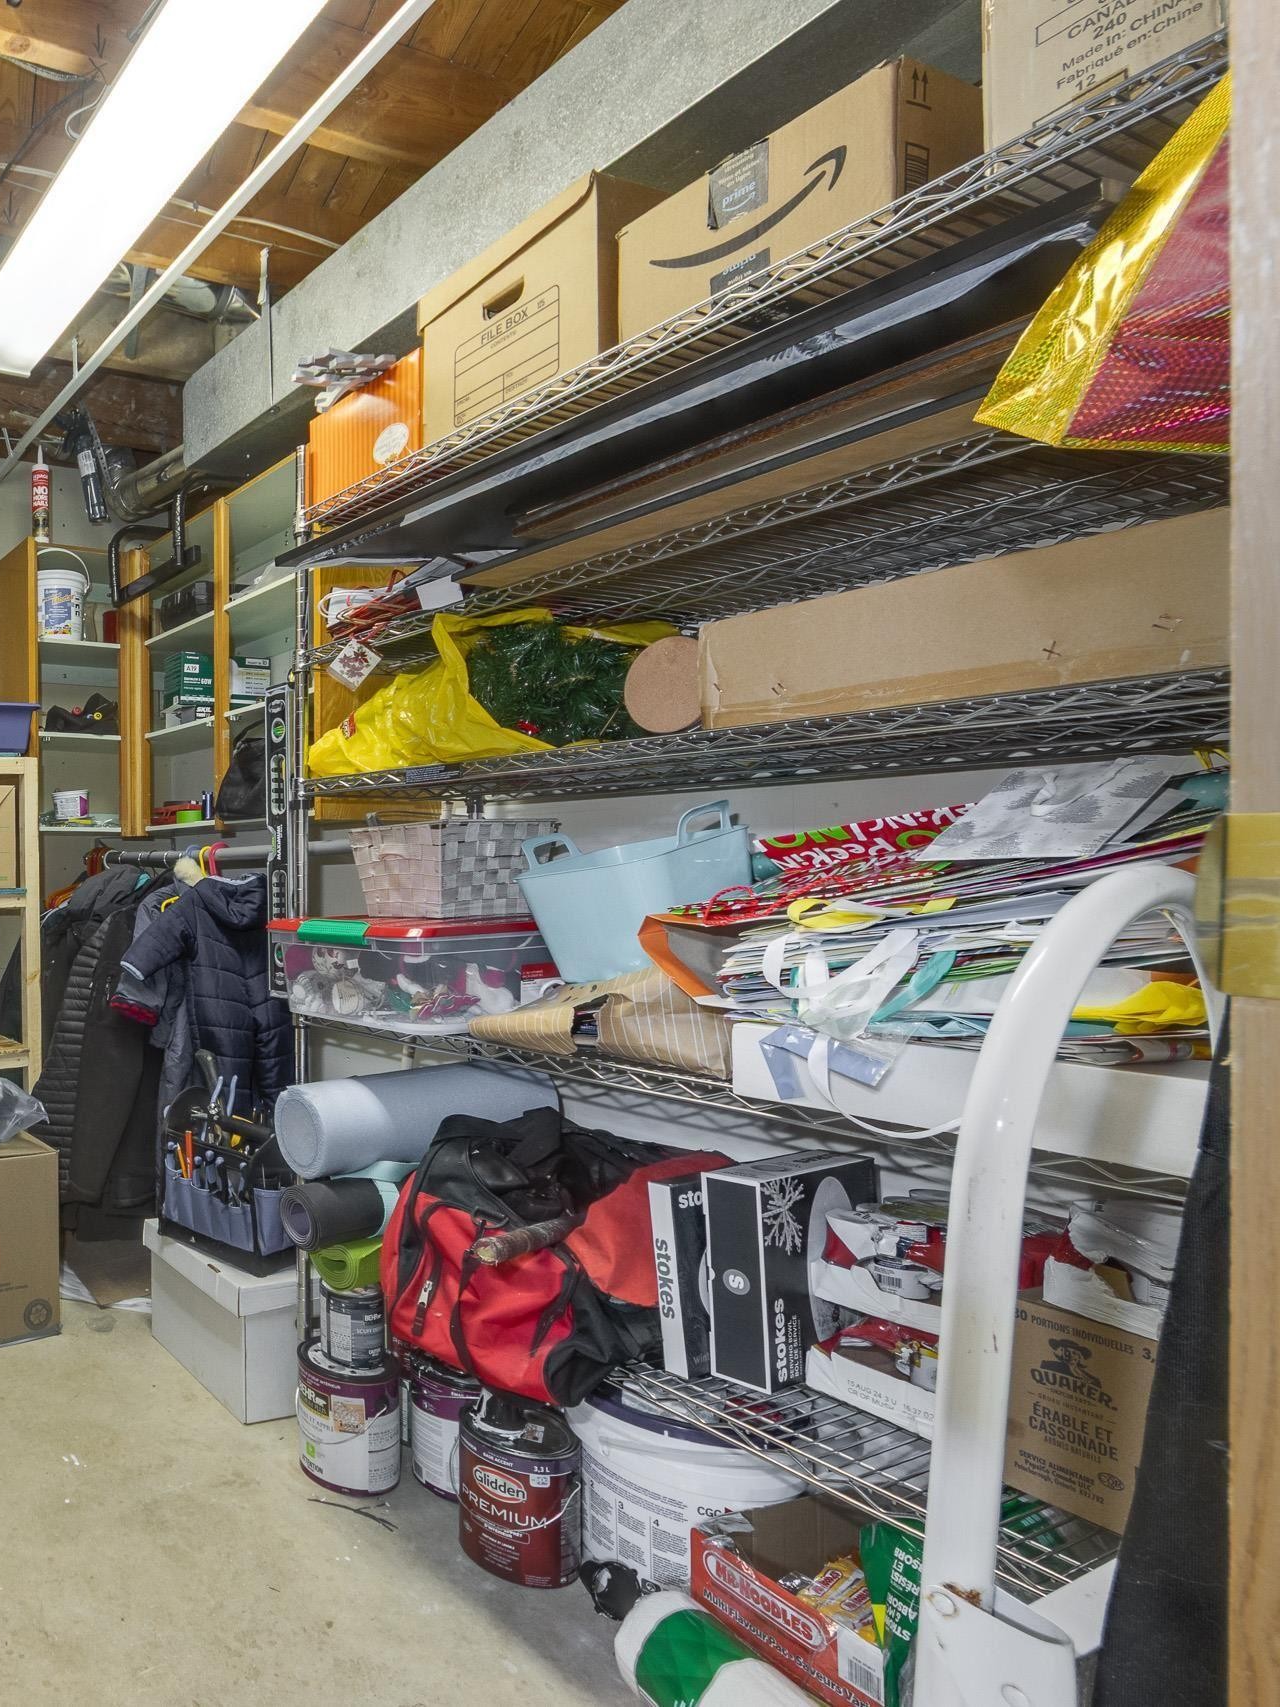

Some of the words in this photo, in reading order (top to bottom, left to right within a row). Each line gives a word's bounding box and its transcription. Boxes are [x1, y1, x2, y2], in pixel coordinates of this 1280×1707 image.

[1093, 12, 1127, 40] 240
[1056, 47, 1124, 89] Fabriqué
[1062, 42, 1102, 71] Made
[1075, 74, 1096, 91] 12
[722, 181, 756, 208] prime
[481, 324, 502, 344] FILE
[506, 307, 529, 329] BOX
[33, 486, 48, 494] NO
[655, 1237, 676, 1320] stokes
[774, 1298, 788, 1383] stokes
[794, 1349, 798, 1359] DE
[1031, 1315, 1070, 1335] PORTIONS
[1072, 1327, 1135, 1355] INDIVIDUELLES
[1030, 1368, 1112, 1407] QUAKER
[1029, 1416, 1118, 1462] CASSONADE
[1033, 1401, 1089, 1435] ÉRABLE
[1095, 1429, 1113, 1443] ET
[474, 1468, 525, 1500] Glidden
[462, 1483, 547, 1529] PREMIUM
[618, 1501, 624, 1510] 3
[653, 1519, 659, 1527] 4
[739, 1578, 814, 1640] NOODLES
[728, 1608, 768, 1640] Flavour
[794, 1653, 843, 1695] Saveurs
